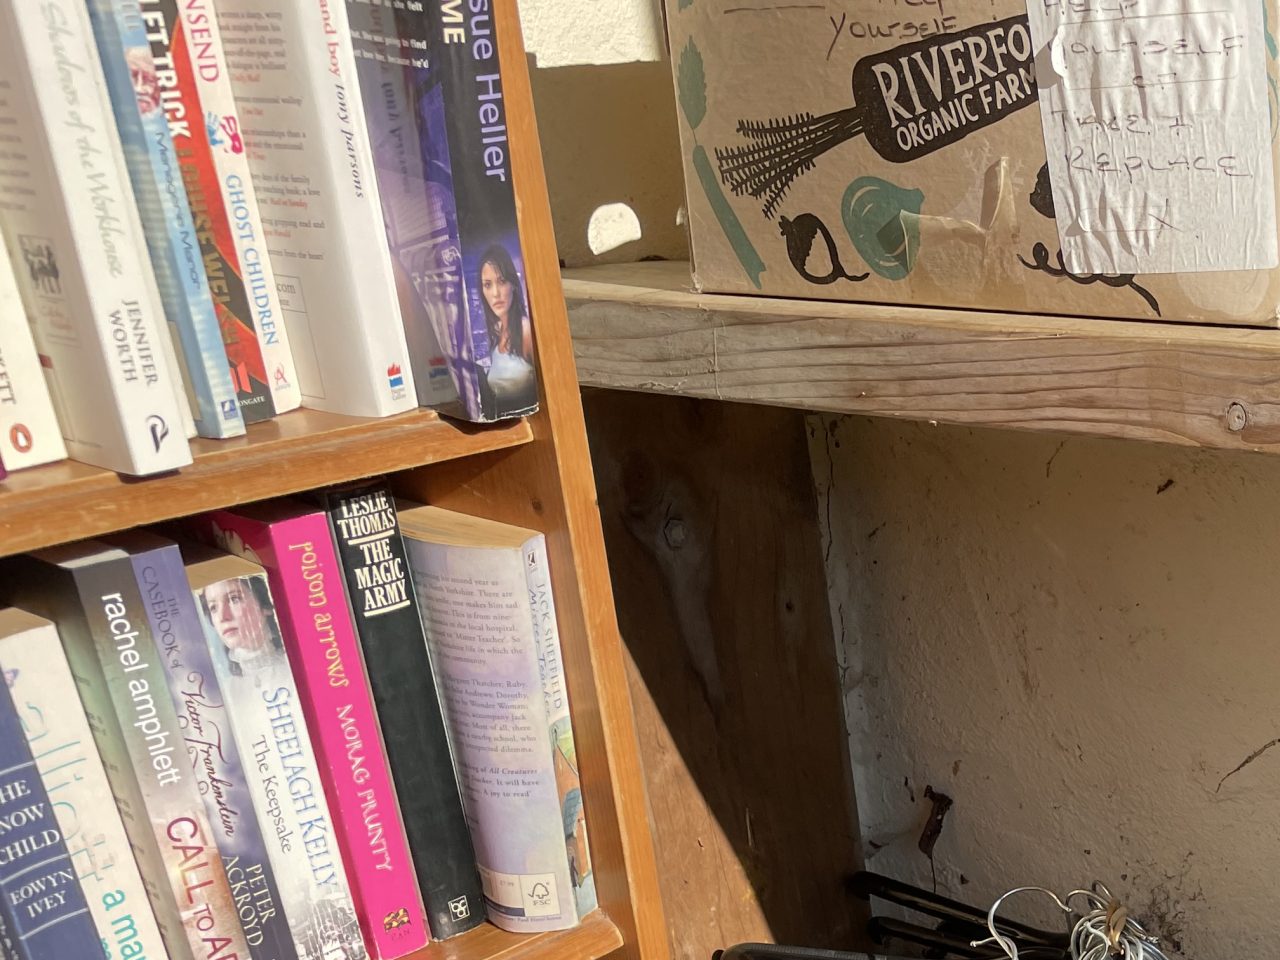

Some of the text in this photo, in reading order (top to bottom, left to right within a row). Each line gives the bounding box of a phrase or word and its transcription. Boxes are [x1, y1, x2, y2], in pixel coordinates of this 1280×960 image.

[186, 0, 219, 83] NSEND
[328, 42, 341, 77] boy
[64, 109, 95, 133] of
[152, 51, 192, 139] TRICK
[335, 83, 349, 124] tony
[476, 73, 508, 182] Heller
[896, 93, 979, 151] ORGANIC
[76, 135, 102, 169] the
[340, 128, 364, 198] parsons
[86, 172, 125, 279] Workhouse
[180, 230, 200, 289] Manor
[226, 174, 279, 346] GHOST CHILDREN
[109, 309, 138, 383] WORTH
[122, 298, 159, 386] JENNIFER
[337, 508, 396, 539] THOMAS
[341, 495, 389, 519] LESLIE
[354, 557, 405, 590] MAGIC
[360, 538, 393, 565] THE
[142, 566, 180, 656] CASEBOOK
[169, 598, 180, 617] THE
[289, 541, 349, 688] poison arrows
[364, 579, 408, 611] ARMY
[536, 583, 562, 709] JACK SHEFFIELD
[101, 592, 181, 786] rachel amphlett
[181, 671, 224, 737] Victor
[184, 720, 239, 838] Frankenstein
[252, 734, 292, 854] The Keepsake
[262, 687, 339, 888] SHEELAGH KELLY
[336, 704, 392, 871] MORAG PRUNTY
[0, 828, 61, 866] CHILD
[167, 817, 215, 904] CALL
[193, 903, 215, 932] TO
[10, 868, 75, 905] EOWYN
[27, 890, 67, 919] IVEY
[103, 889, 125, 911] a
[222, 856, 264, 946] ACKROYD
[246, 864, 276, 924] PETER
